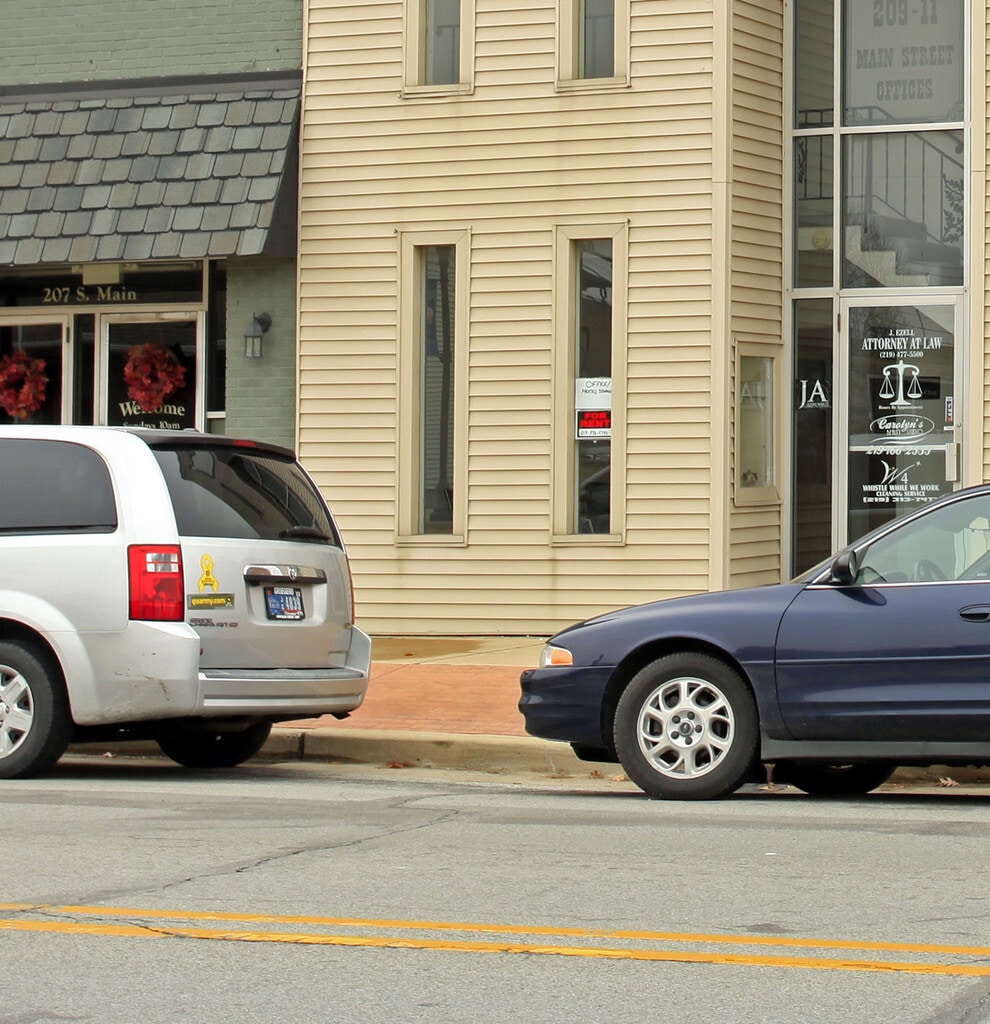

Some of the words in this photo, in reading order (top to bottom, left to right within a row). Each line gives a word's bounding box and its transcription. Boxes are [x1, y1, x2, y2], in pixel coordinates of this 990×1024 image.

[856, 47, 893, 69] MAIN
[901, 44, 954, 67] STREET
[877, 78, 933, 101] OFFICES
[43, 287, 70, 303] 207
[76, 287, 90, 302] S.
[97, 287, 137, 301] Main
[861, 337, 909, 350] ATTORNEY
[910, 337, 922, 350] AT
[923, 337, 943, 350] LAW
[118, 401, 186, 417] Weome
[584, 411, 607, 419] FOR
[580, 419, 610, 428] RENT
[877, 418, 924, 433] Carolyn's
[862, 484, 888, 492] WHISTLE
[889, 484, 908, 492] WHILE
[909, 484, 920, 492] WE
[920, 484, 940, 492] WORK
